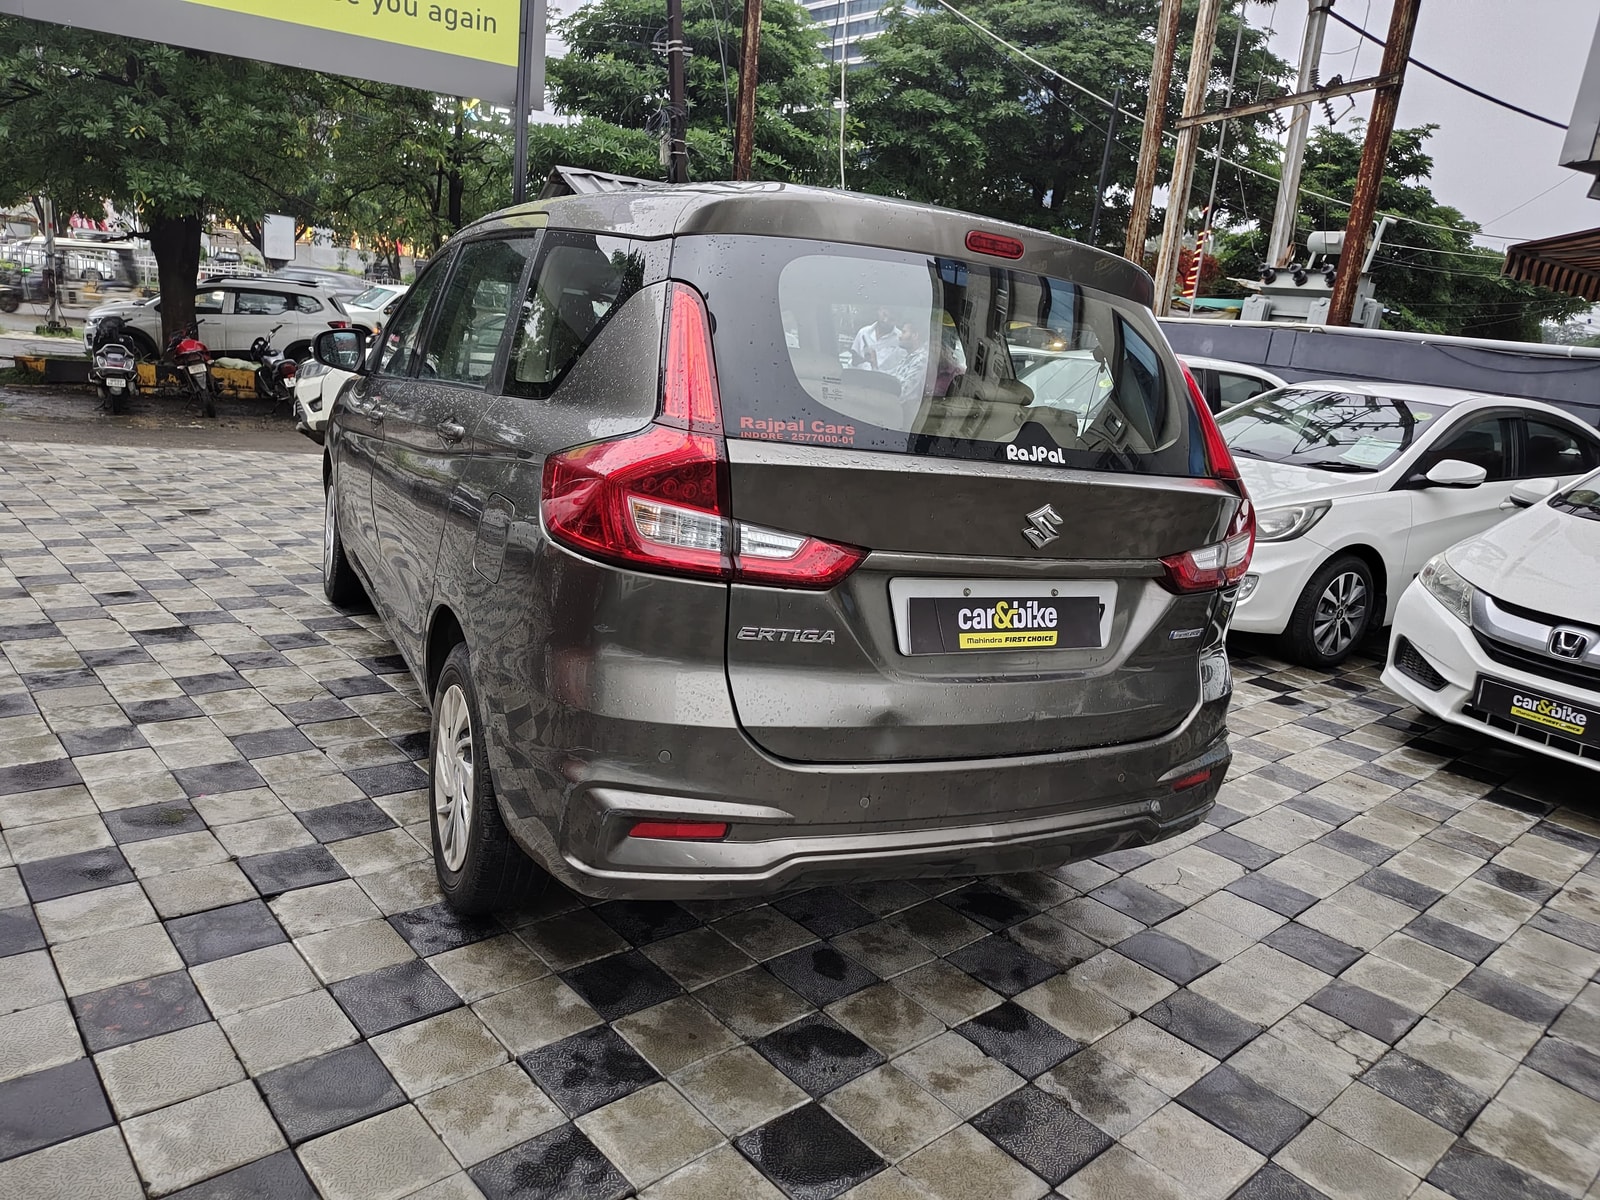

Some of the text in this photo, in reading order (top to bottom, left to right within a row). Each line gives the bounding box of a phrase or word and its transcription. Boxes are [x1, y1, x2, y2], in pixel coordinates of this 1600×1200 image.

[372, 0, 497, 34] you again
[740, 417, 855, 435] Rajpal Cars
[740, 431, 784, 440] INDORE
[791, 433, 855, 445] 2577000-01
[958, 600, 1058, 630] car&bike
[737, 626, 836, 644] ERTIGA
[966, 637, 1003, 645] Mahindra
[1513, 695, 1587, 725] car&bike
